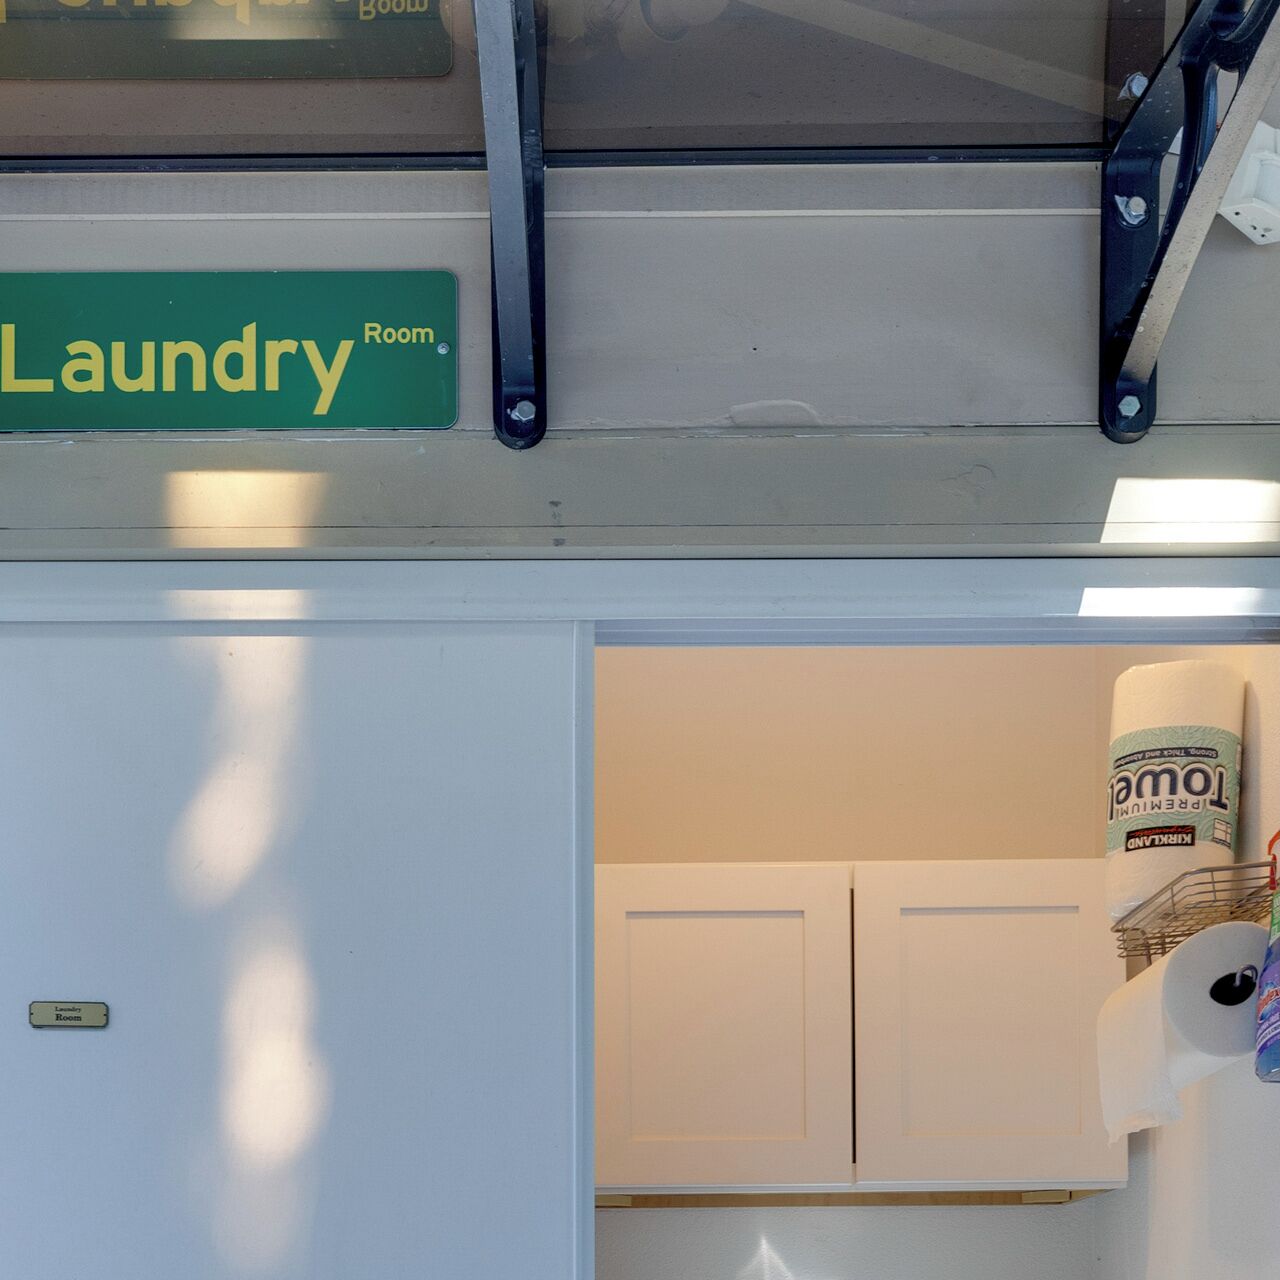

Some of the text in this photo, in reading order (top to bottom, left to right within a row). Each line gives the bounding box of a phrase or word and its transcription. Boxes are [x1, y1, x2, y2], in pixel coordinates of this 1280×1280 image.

[0, 320, 435, 416] Laundry Room
[1108, 766, 1229, 821] Towel
[1120, 798, 1201, 817] PREMIUM
[1126, 833, 1193, 849] KIRKLAND
[55, 1013, 82, 1022] Room
